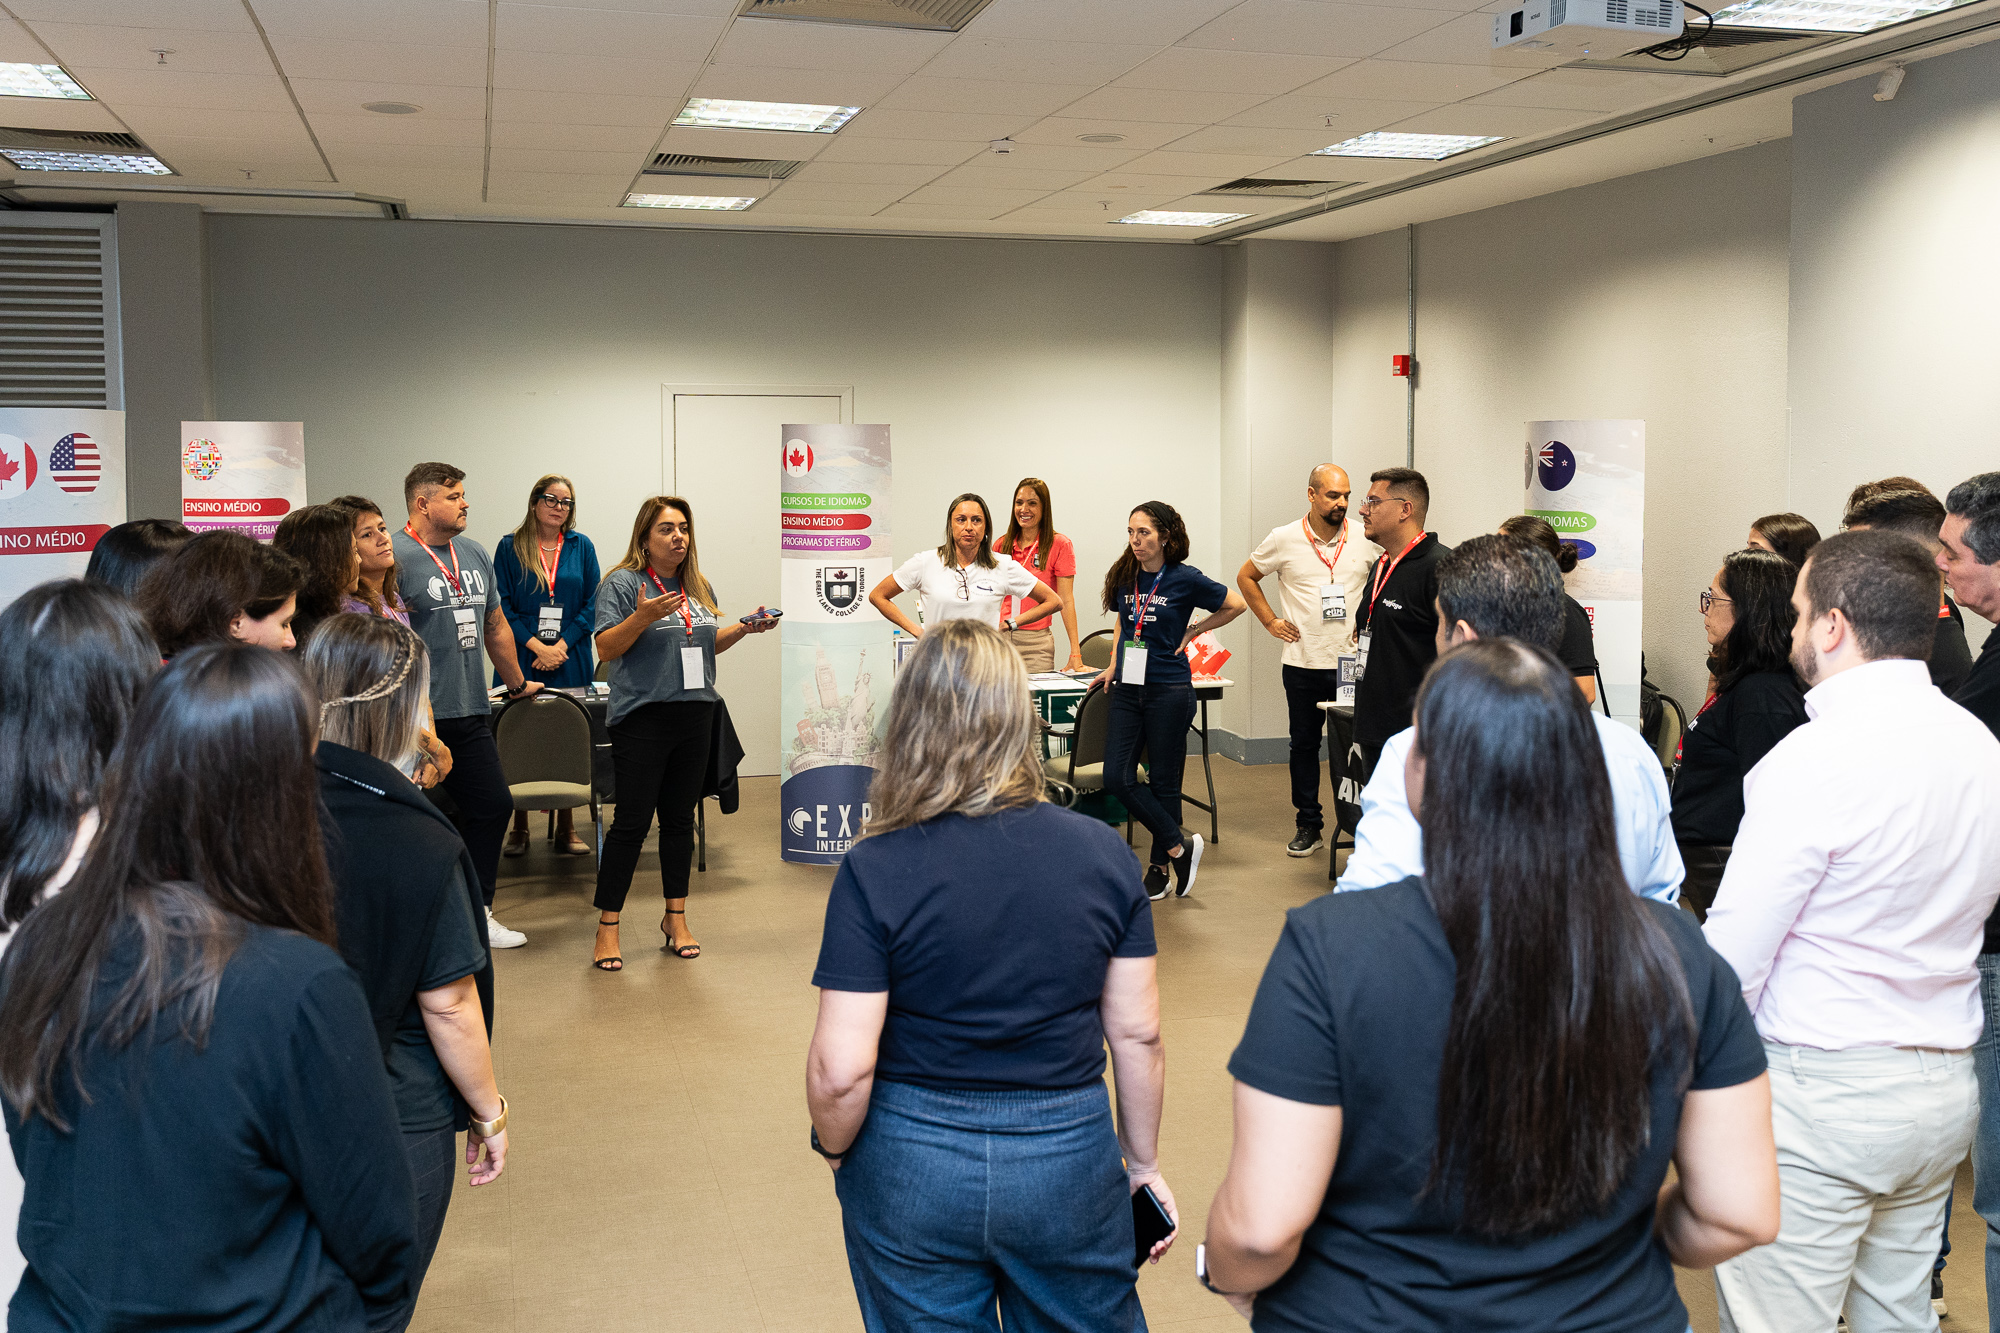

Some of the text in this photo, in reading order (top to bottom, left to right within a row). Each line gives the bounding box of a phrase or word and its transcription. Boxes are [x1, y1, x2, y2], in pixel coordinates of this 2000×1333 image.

[184, 501, 262, 513] ENSINO MÉDIO
[782, 496, 867, 506] CURSOS DE IDIOMAS
[782, 515, 844, 527] ENSINO MÉDIO
[36, 530, 86, 548] MÉDIO
[782, 536, 861, 547] PROGRAMAS DE FÉRIAS
[815, 580, 823, 598] GREAT
[857, 594, 864, 602] OF
[818, 598, 835, 615] LAKES
[835, 601, 860, 617] COLLEGE
[816, 839, 854, 853] INTER
